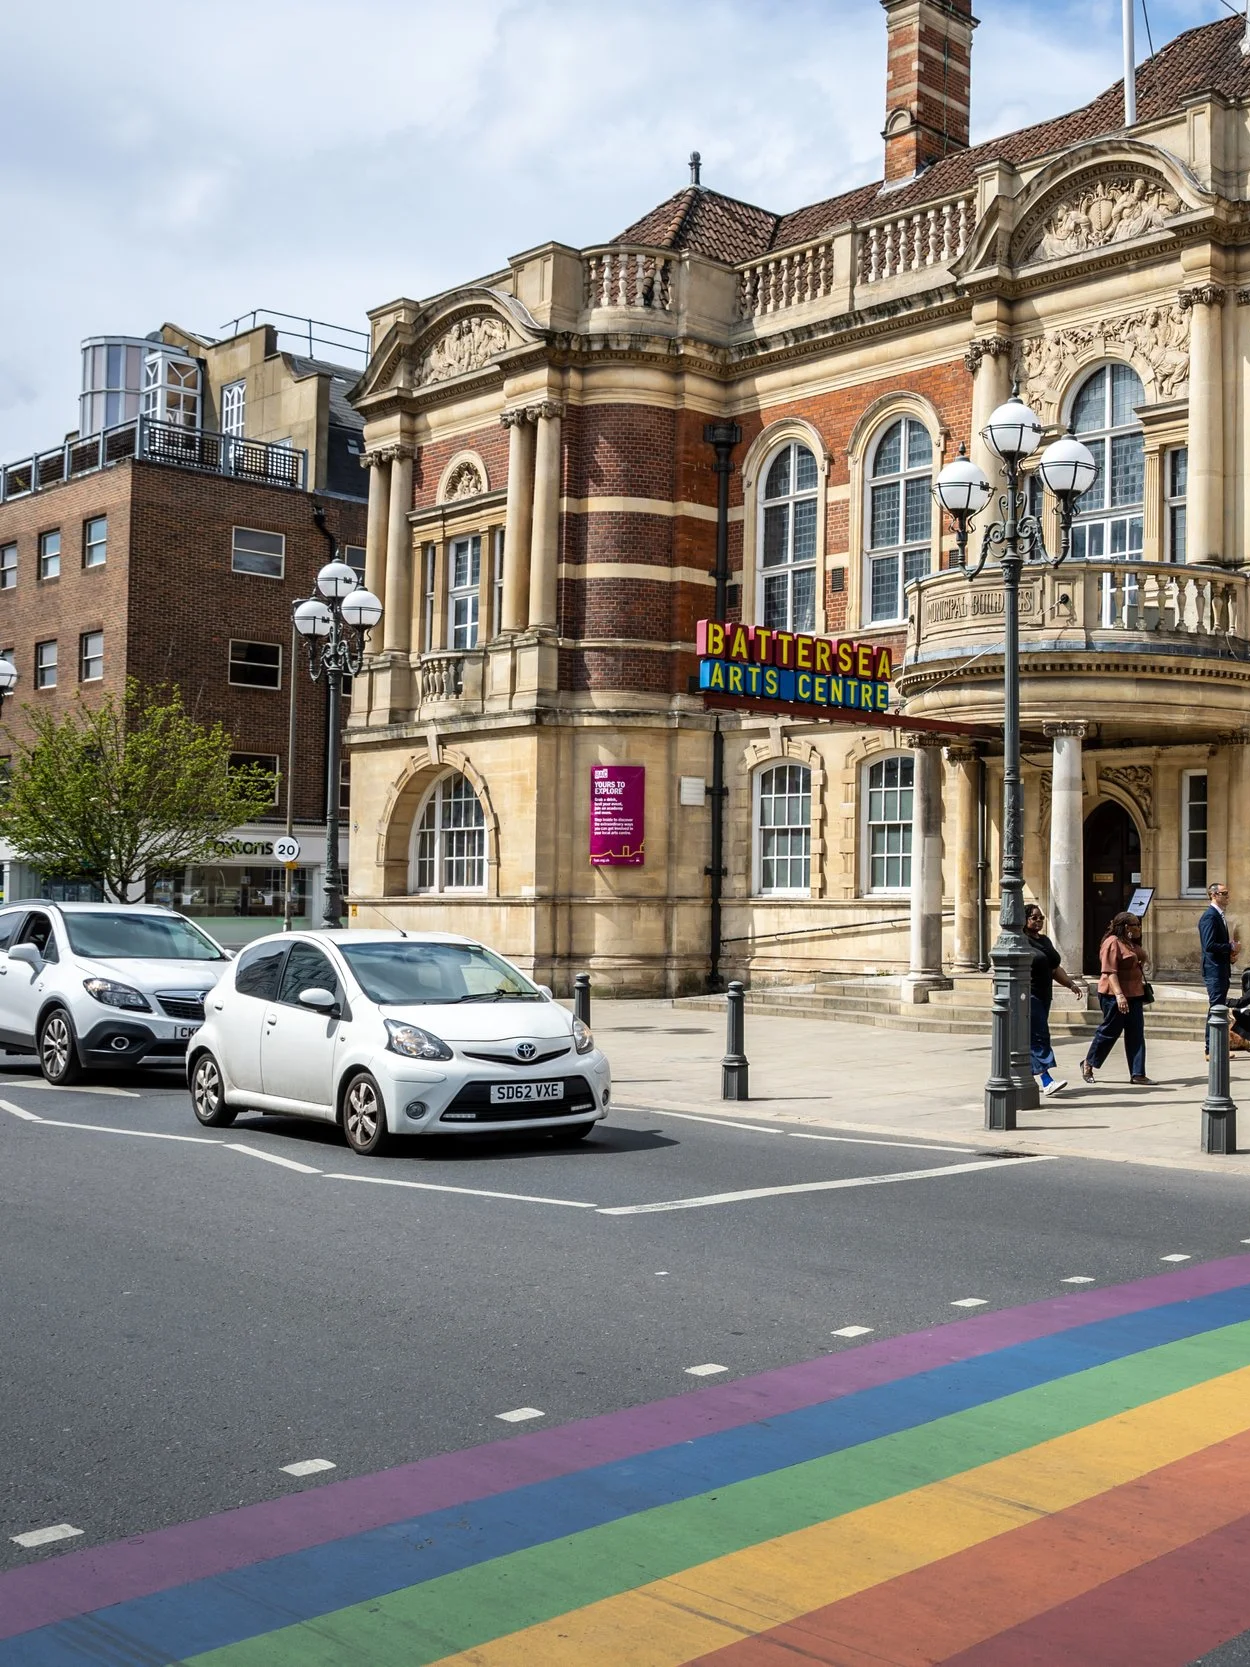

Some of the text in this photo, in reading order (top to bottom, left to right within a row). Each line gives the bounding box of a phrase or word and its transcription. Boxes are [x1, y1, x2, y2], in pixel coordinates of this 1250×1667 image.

[926, 589, 1032, 623] MUNICIPAL BUILDGS
[708, 623, 891, 681] BATTERSEA
[711, 662, 888, 708] ARTS CENTRE
[208, 837, 273, 855] oxtons
[278, 844, 295, 855] 20
[180, 1027, 201, 1038] CK
[497, 1083, 559, 1100] SD62 VXE
